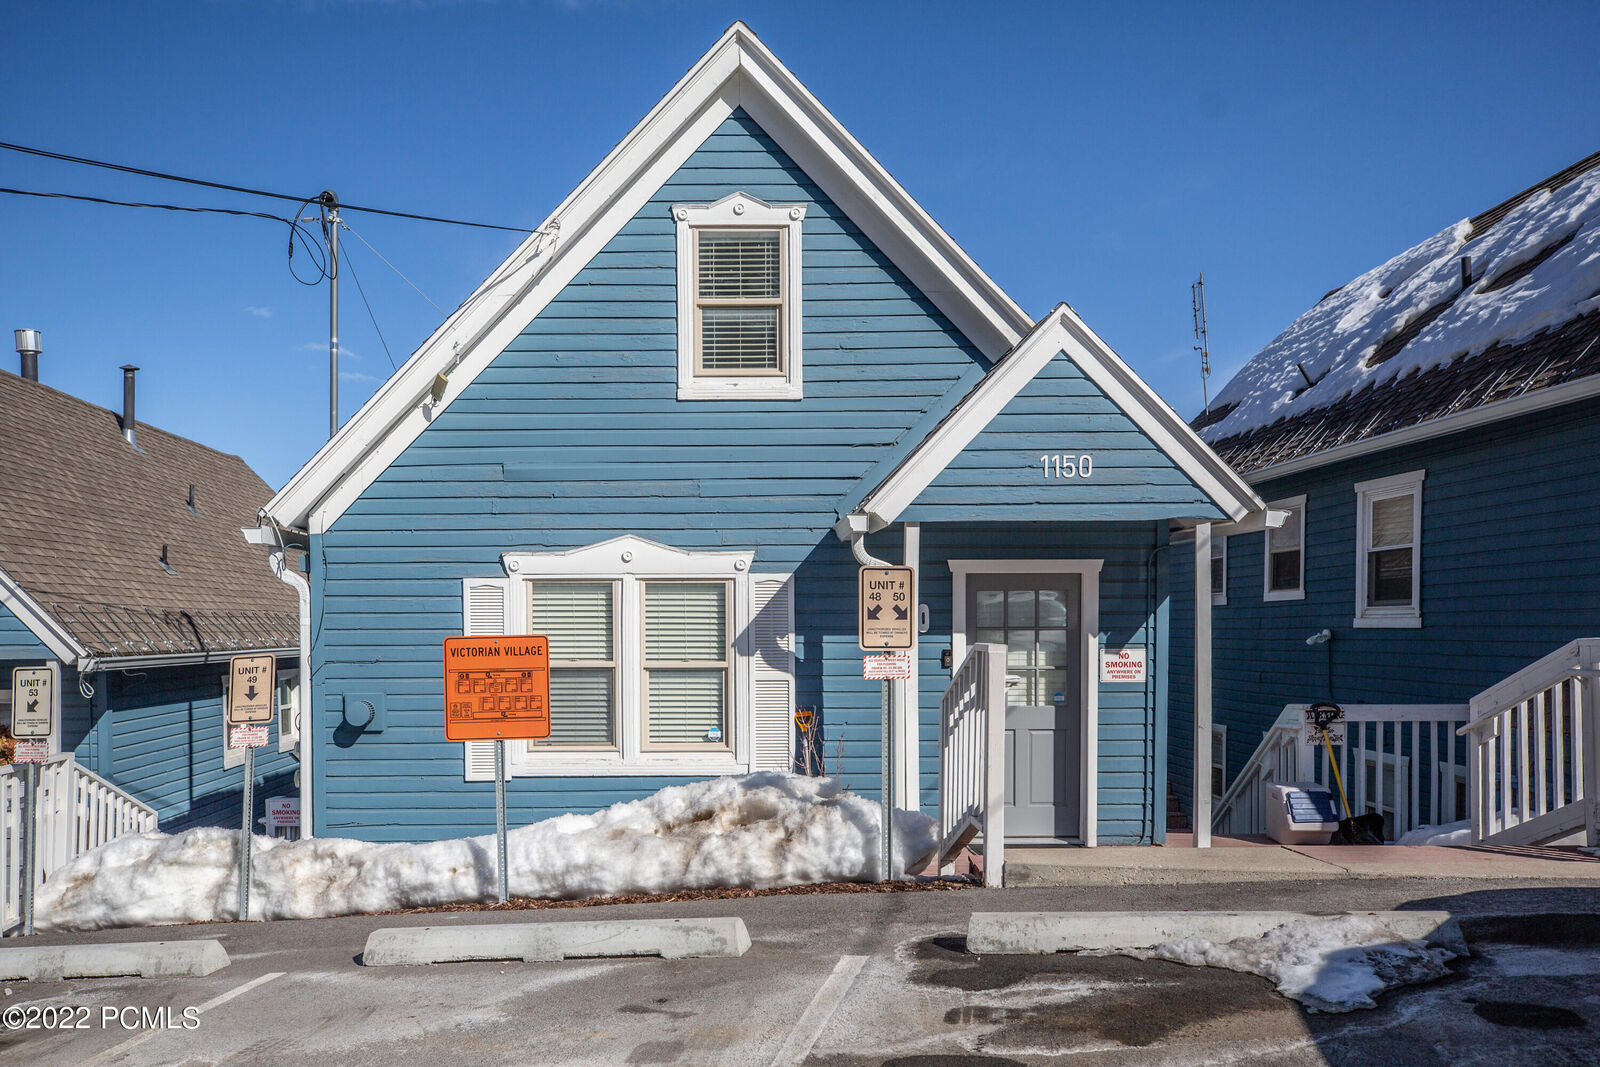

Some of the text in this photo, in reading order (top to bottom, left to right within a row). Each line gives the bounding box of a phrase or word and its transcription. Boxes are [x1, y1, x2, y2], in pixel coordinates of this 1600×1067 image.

[1040, 454, 1093, 478] 1150
[869, 581, 905, 590] UNIT #
[869, 592, 906, 601] 48 50
[450, 646, 543, 657] VICTORIAN VILLAGE
[238, 667, 259, 675] UNIT
